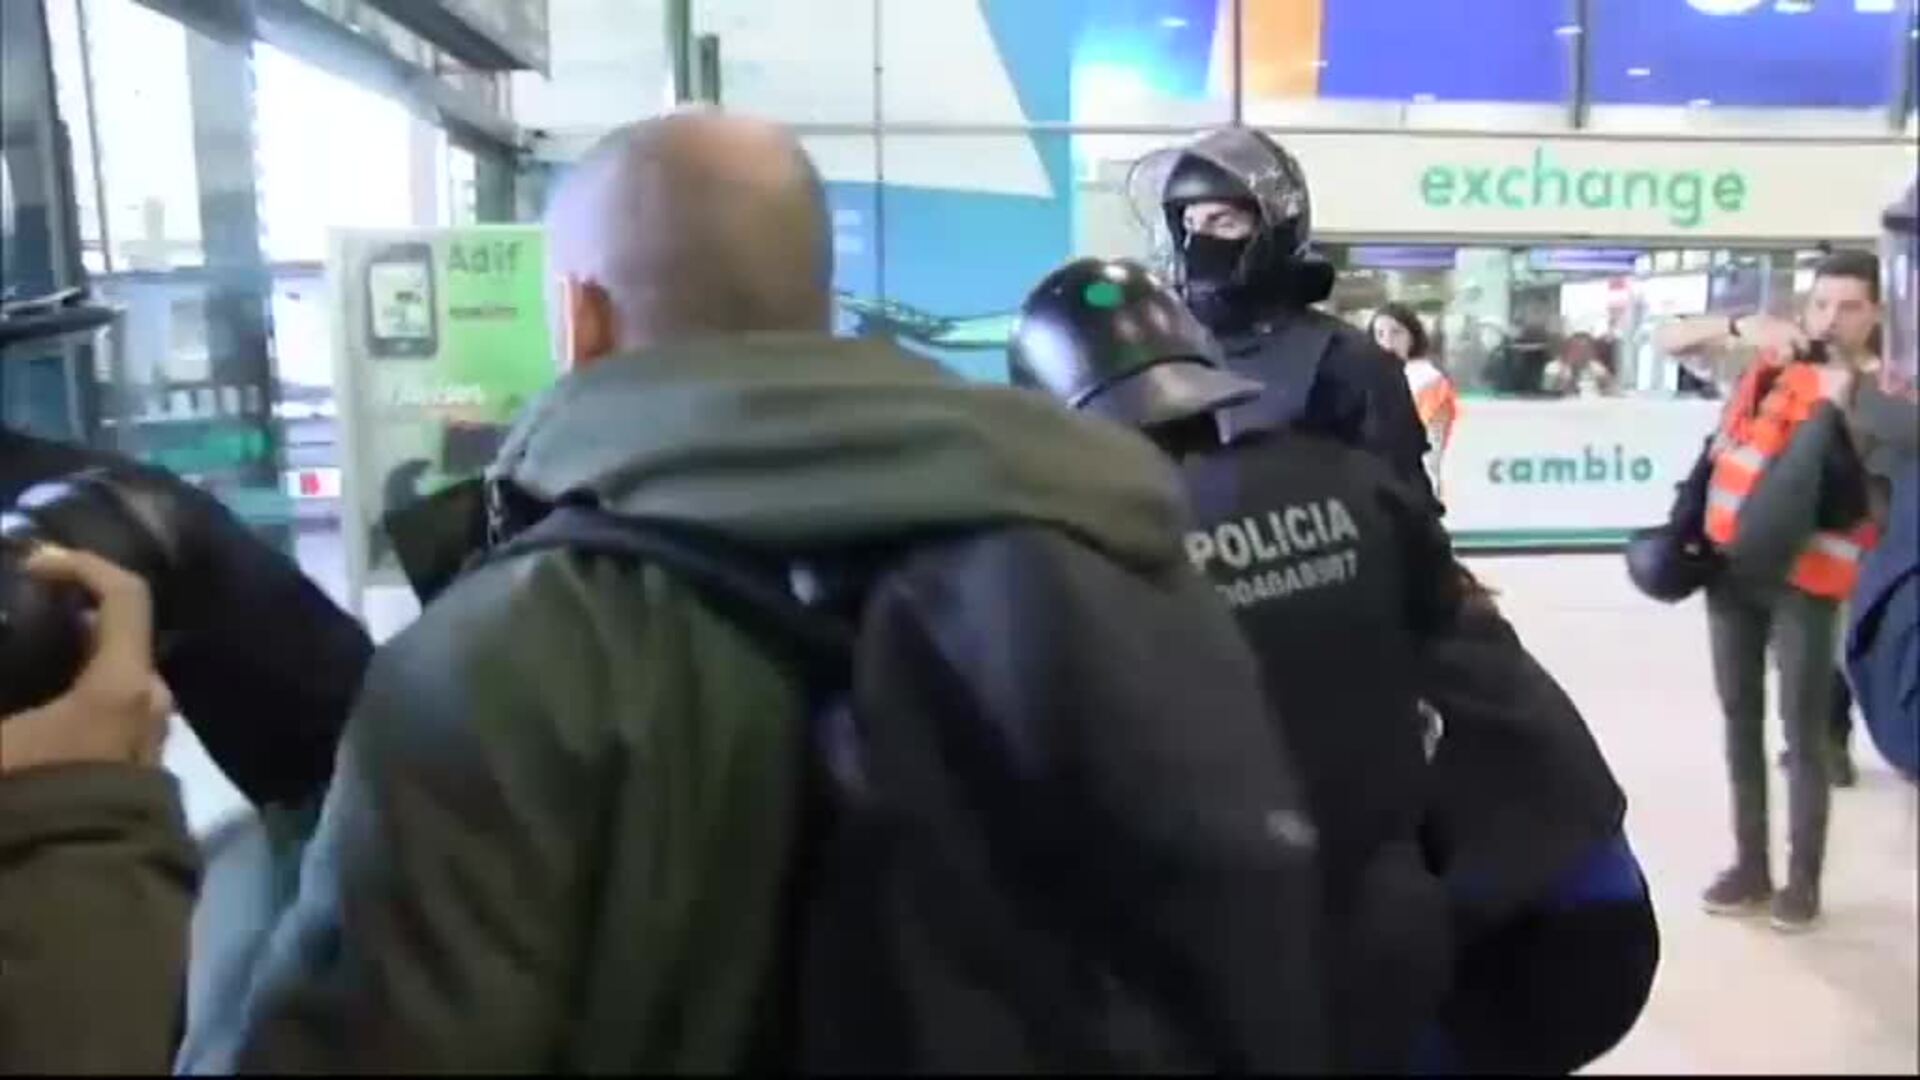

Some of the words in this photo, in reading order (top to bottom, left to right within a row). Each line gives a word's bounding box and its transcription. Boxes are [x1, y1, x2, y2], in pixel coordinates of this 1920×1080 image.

[1420, 145, 1746, 228] exchange
[448, 240, 524, 274] Adif
[1488, 445, 1654, 484] cambio
[1182, 496, 1360, 574] POLICIA
